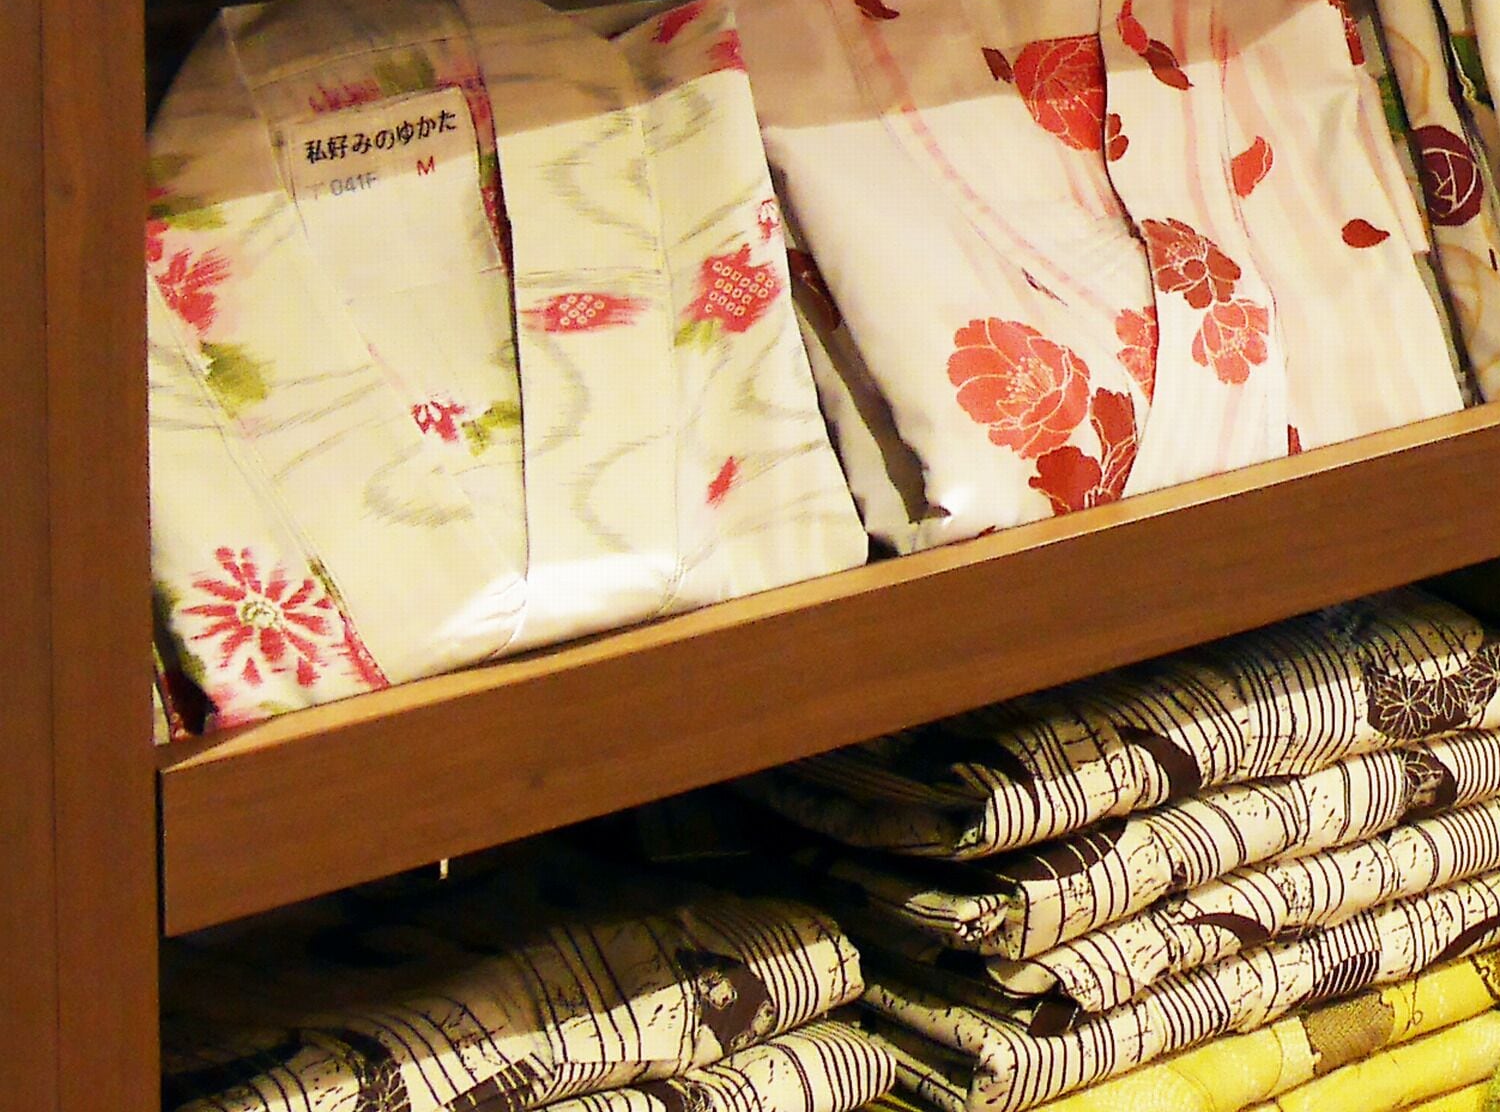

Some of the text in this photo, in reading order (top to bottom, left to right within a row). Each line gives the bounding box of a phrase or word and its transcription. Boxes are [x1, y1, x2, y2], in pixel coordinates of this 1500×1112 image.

[304, 109, 458, 165] 私好みのゆかた
[415, 154, 437, 177] M
